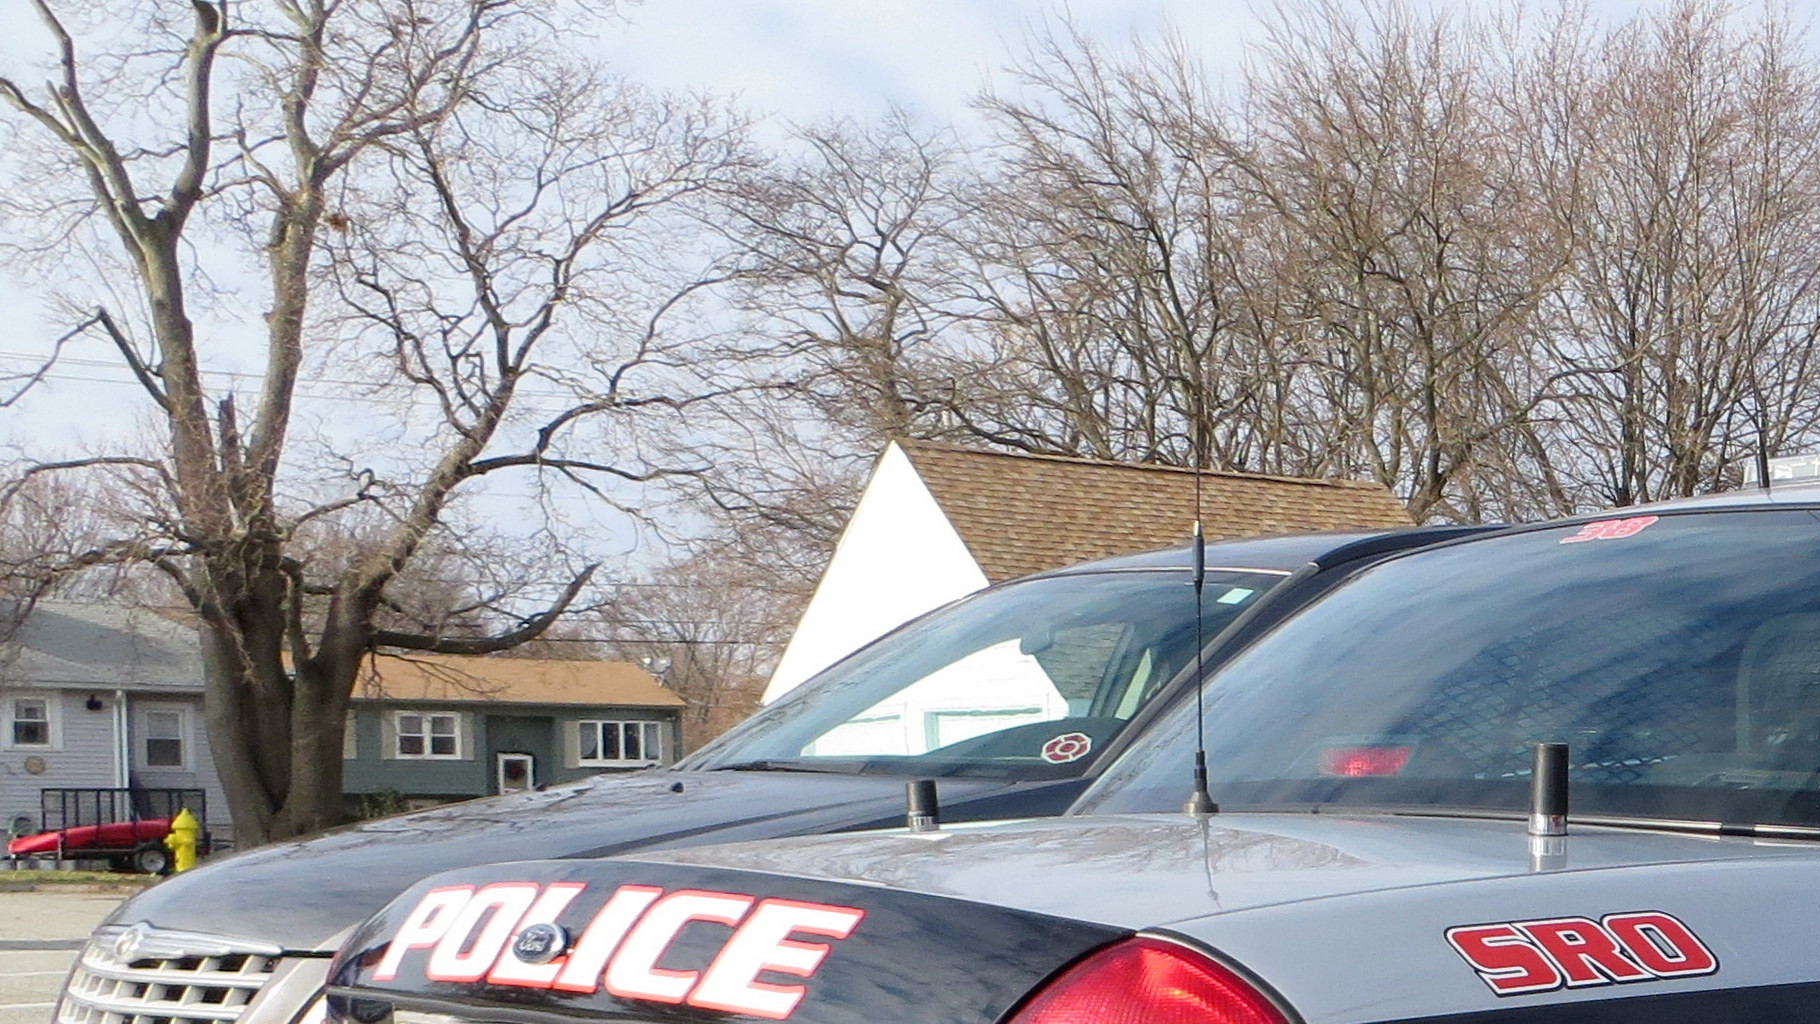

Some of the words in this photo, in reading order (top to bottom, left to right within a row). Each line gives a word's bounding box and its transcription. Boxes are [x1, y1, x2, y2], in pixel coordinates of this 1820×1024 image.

[1559, 515, 1659, 544] 38
[373, 882, 866, 1019] POLICE
[1444, 910, 1720, 997] SRO
